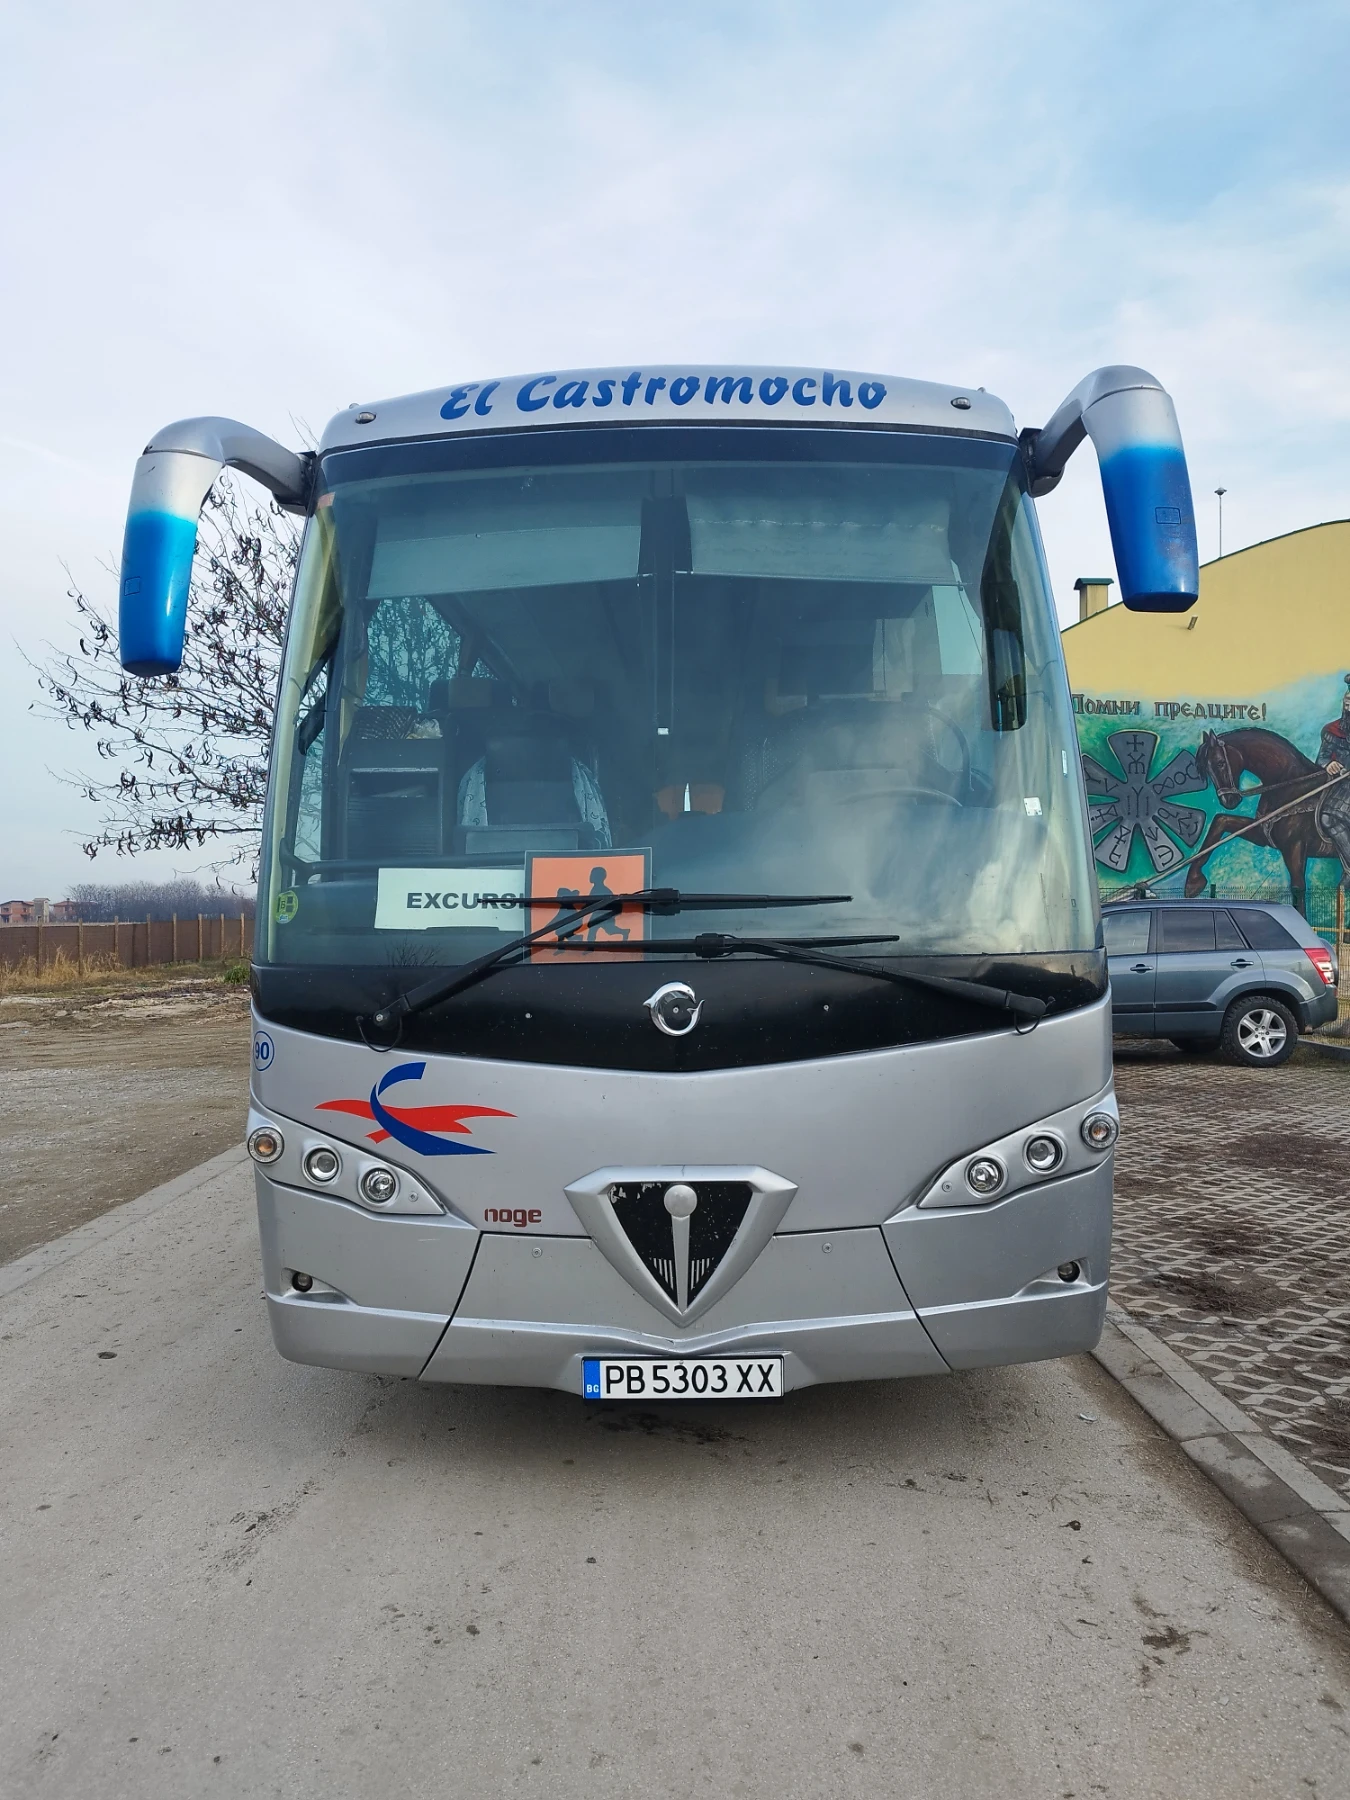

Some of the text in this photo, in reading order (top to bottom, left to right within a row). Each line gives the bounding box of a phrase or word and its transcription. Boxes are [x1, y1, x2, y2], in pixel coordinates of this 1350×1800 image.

[439, 371, 888, 420] El Castromocho
[484, 1208, 542, 1228] noge
[586, 1384, 599, 1393] BG
